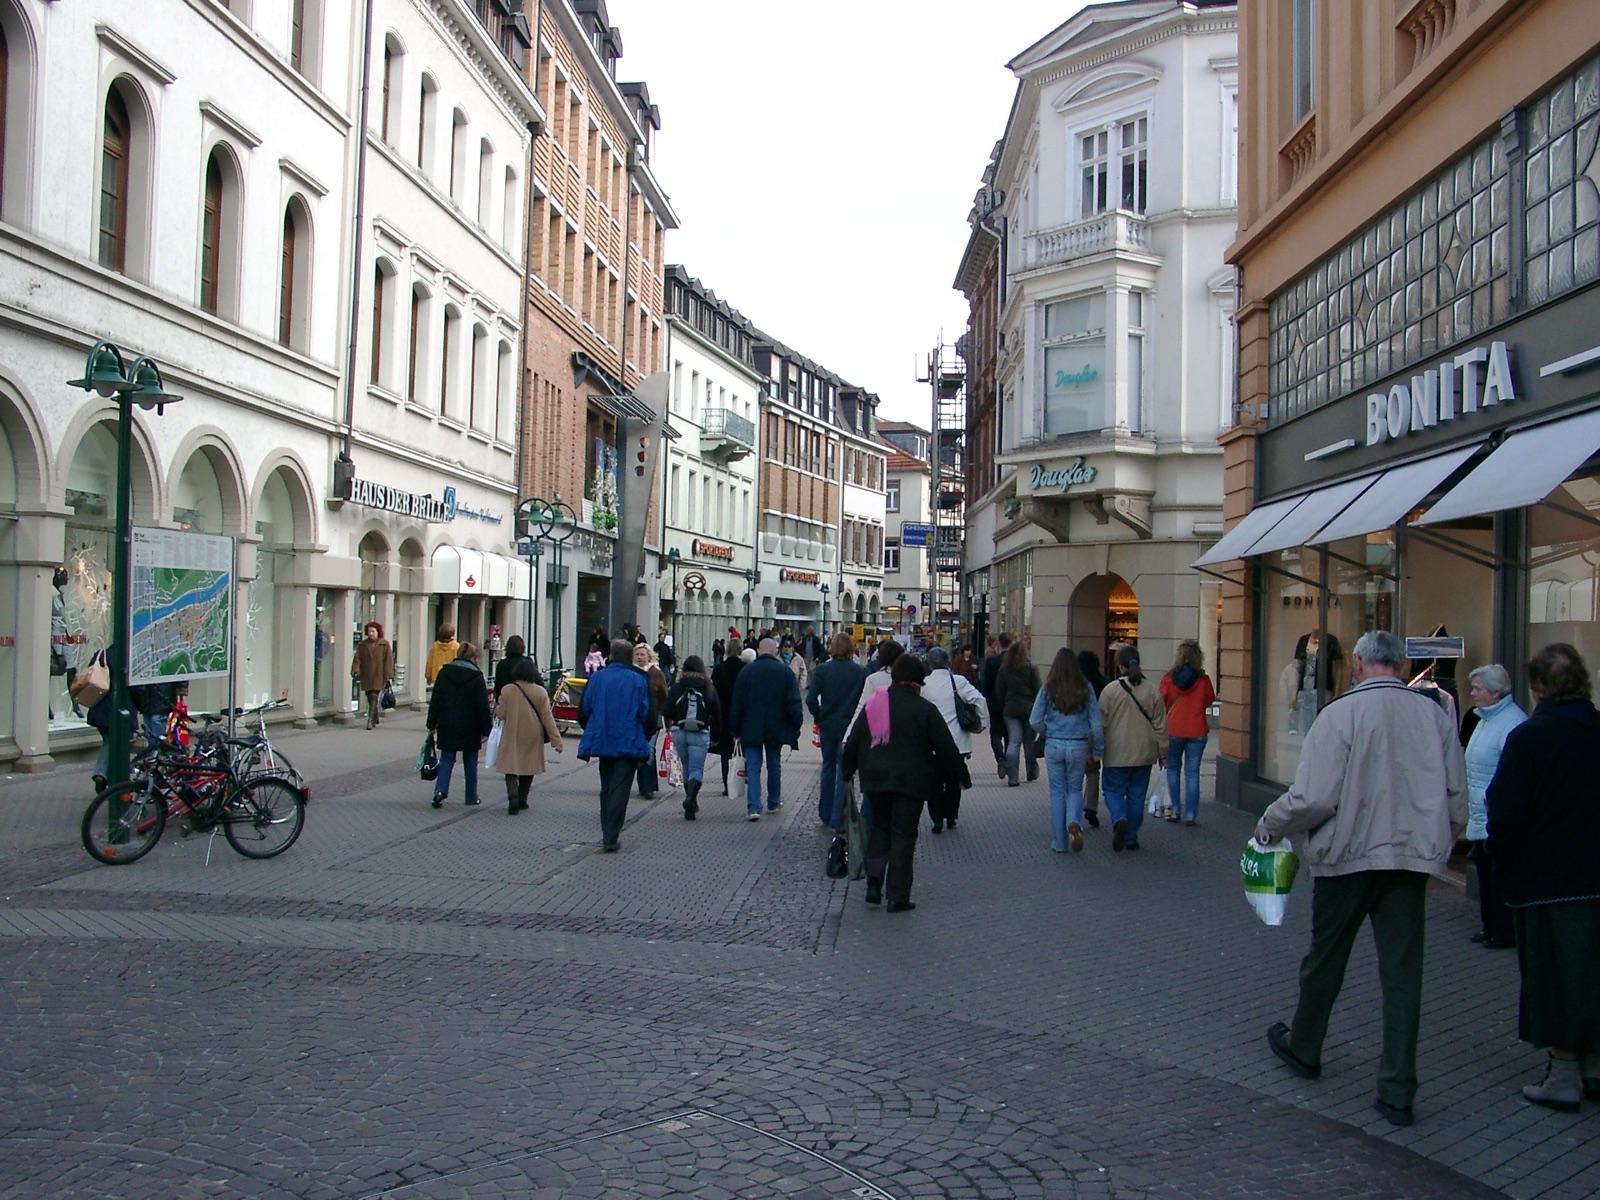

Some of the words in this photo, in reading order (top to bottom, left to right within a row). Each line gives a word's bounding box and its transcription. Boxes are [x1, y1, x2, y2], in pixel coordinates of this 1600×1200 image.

[1055, 364, 1097, 388] Douglas
[1367, 341, 1515, 446] BONITA
[1028, 456, 1097, 493] Douglas
[350, 477, 385, 509] HAUS
[386, 486, 410, 515] DER
[411, 494, 450, 523] BRILLE
[699, 541, 731, 559] SPORTARENA
[786, 570, 817, 583] SPORTARENA
